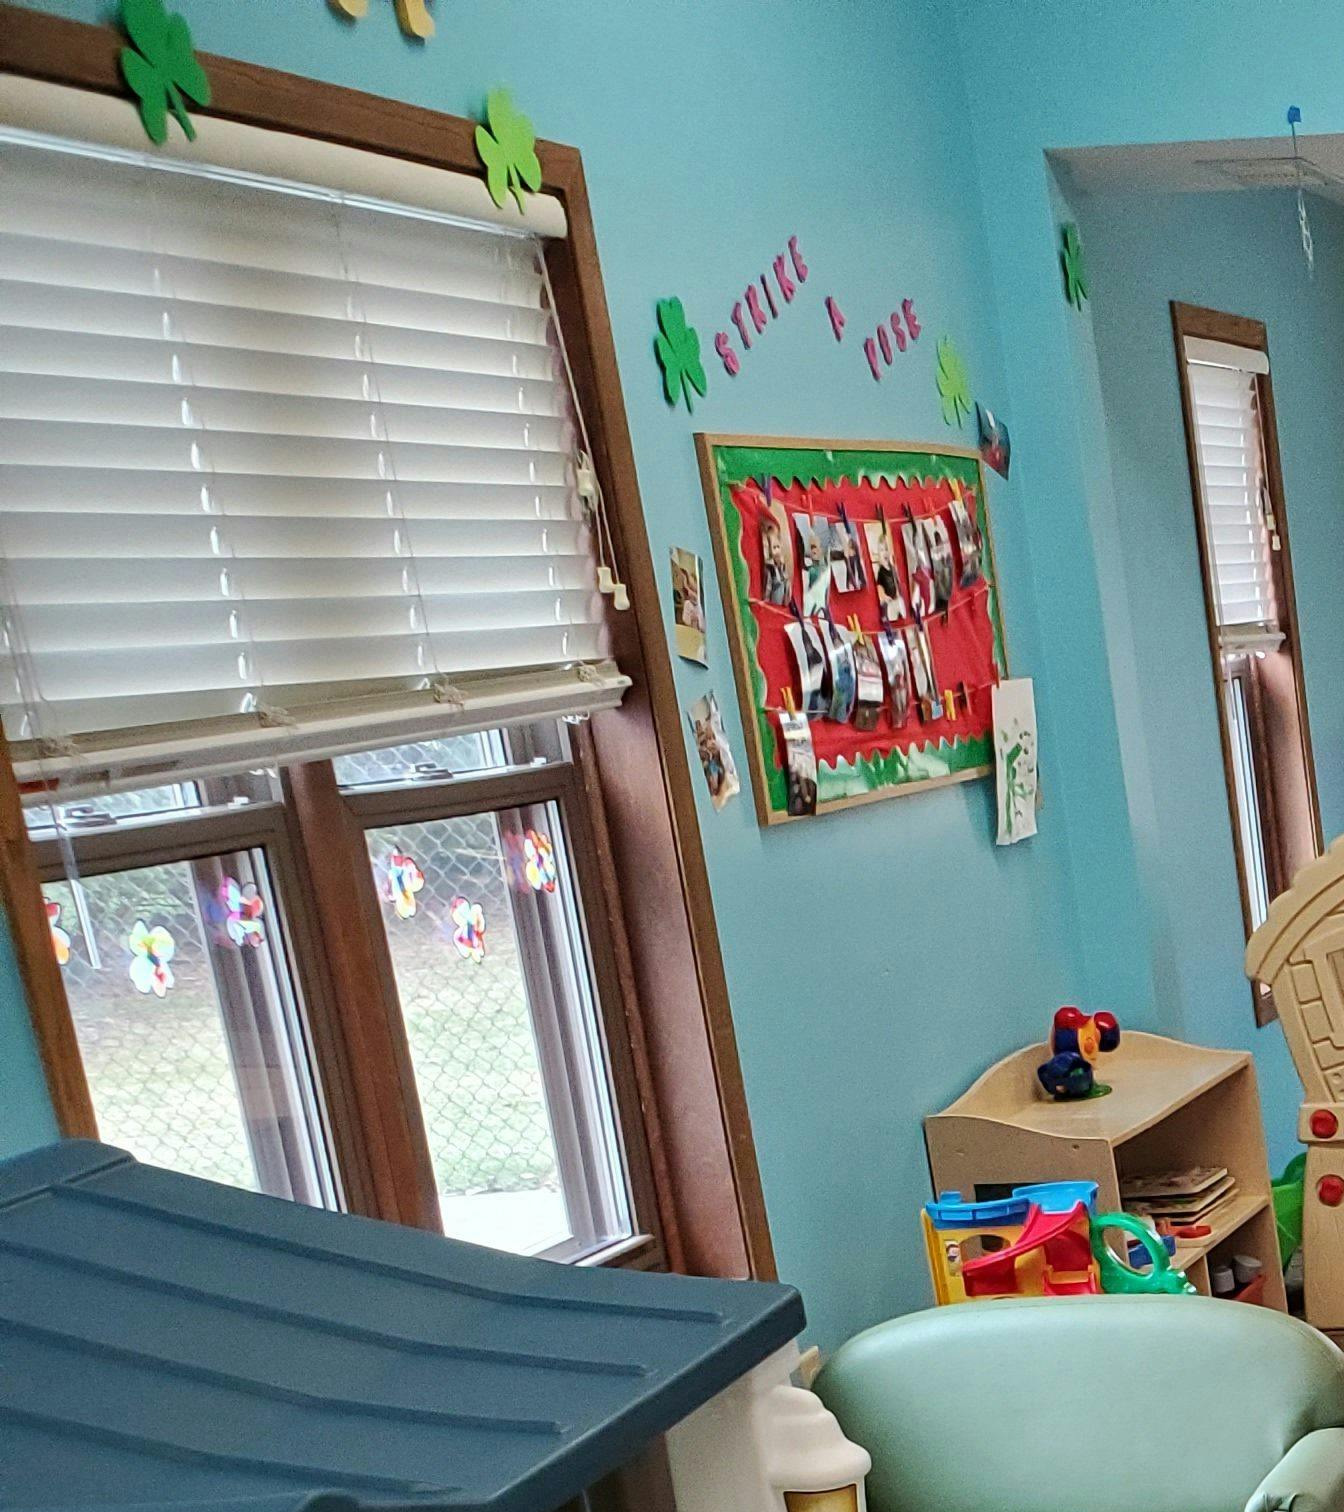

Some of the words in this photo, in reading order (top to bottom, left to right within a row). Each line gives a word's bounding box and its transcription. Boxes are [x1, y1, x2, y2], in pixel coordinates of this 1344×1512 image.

[715, 235, 808, 377] STRIKE
[824, 296, 845, 342] A
[864, 298, 922, 382] POSE
